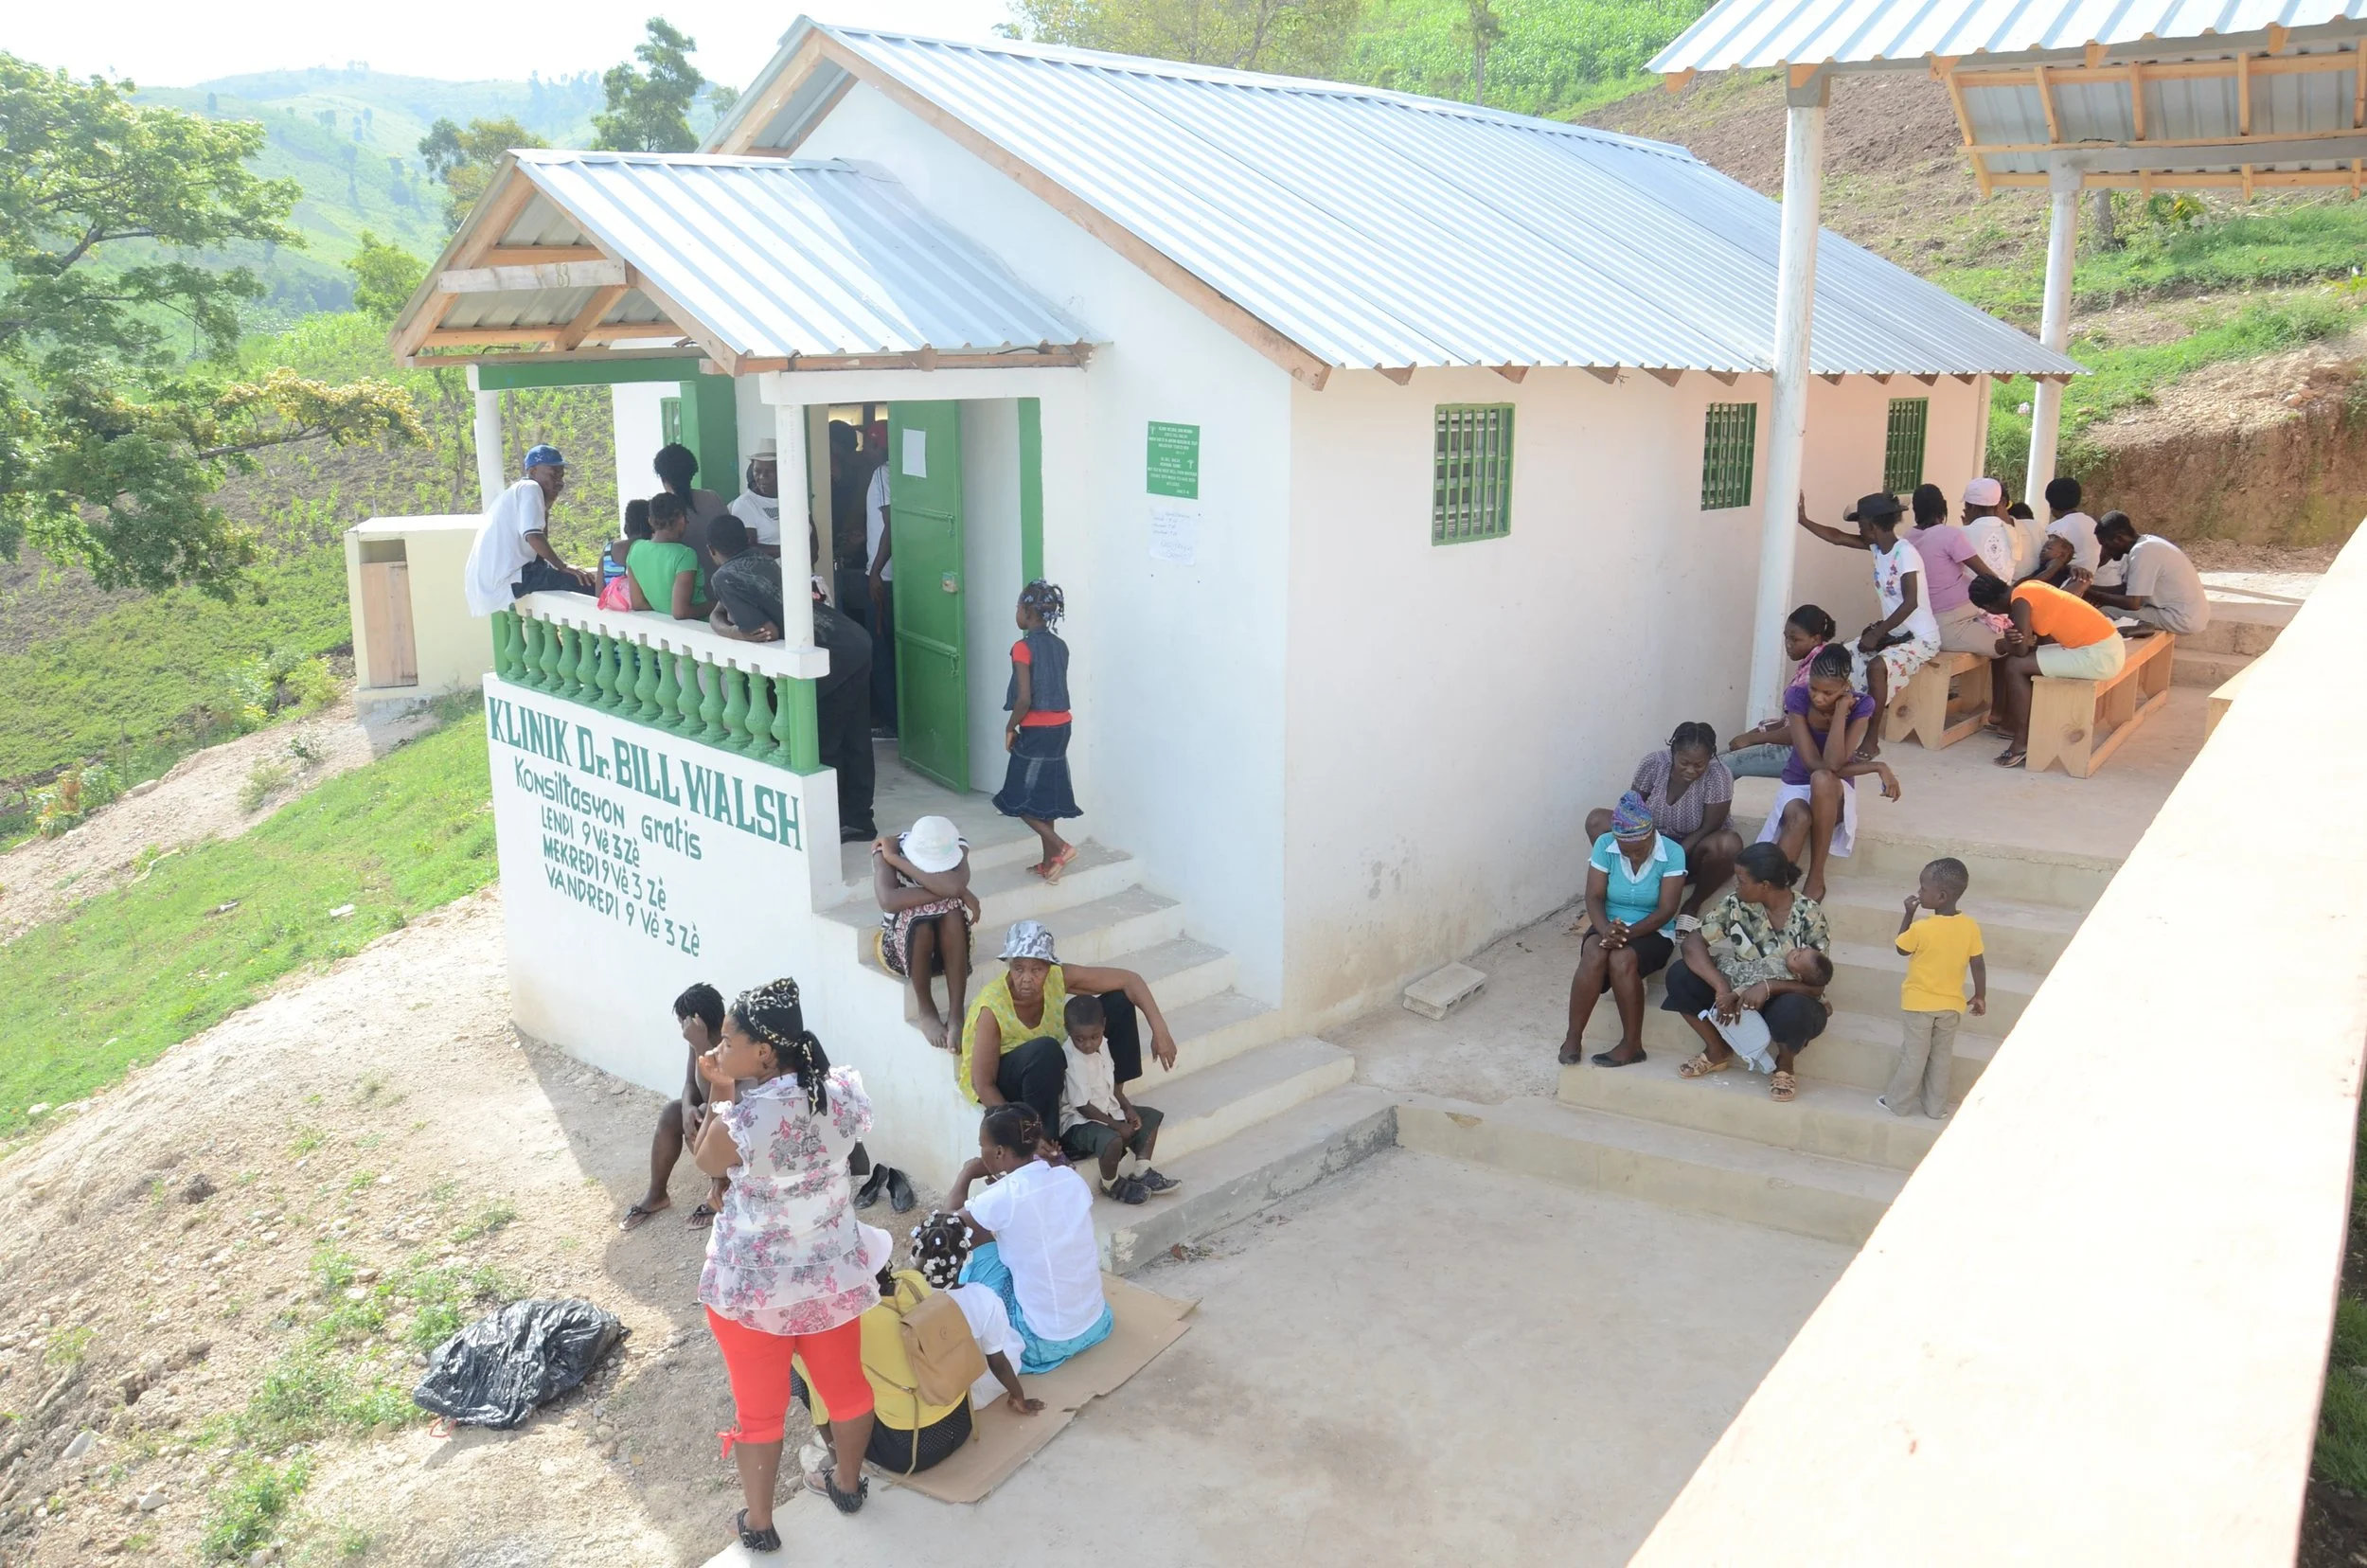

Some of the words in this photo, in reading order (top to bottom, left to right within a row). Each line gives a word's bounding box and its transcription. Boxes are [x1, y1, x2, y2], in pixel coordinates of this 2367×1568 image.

[489, 696, 572, 767] KLINIK
[576, 724, 612, 780] Dr.
[612, 737, 681, 807] BILL
[681, 758, 803, 851] WALSH
[541, 805, 574, 840] LENDI
[543, 833, 599, 881] MEKREDI
[632, 872, 643, 900] 3
[647, 876, 667, 911] Zè
[544, 863, 618, 920] VANDREDI
[626, 901, 634, 926] 9
[640, 907, 660, 938] Vè
[665, 918, 675, 946] 3
[678, 921, 700, 957] Zè
